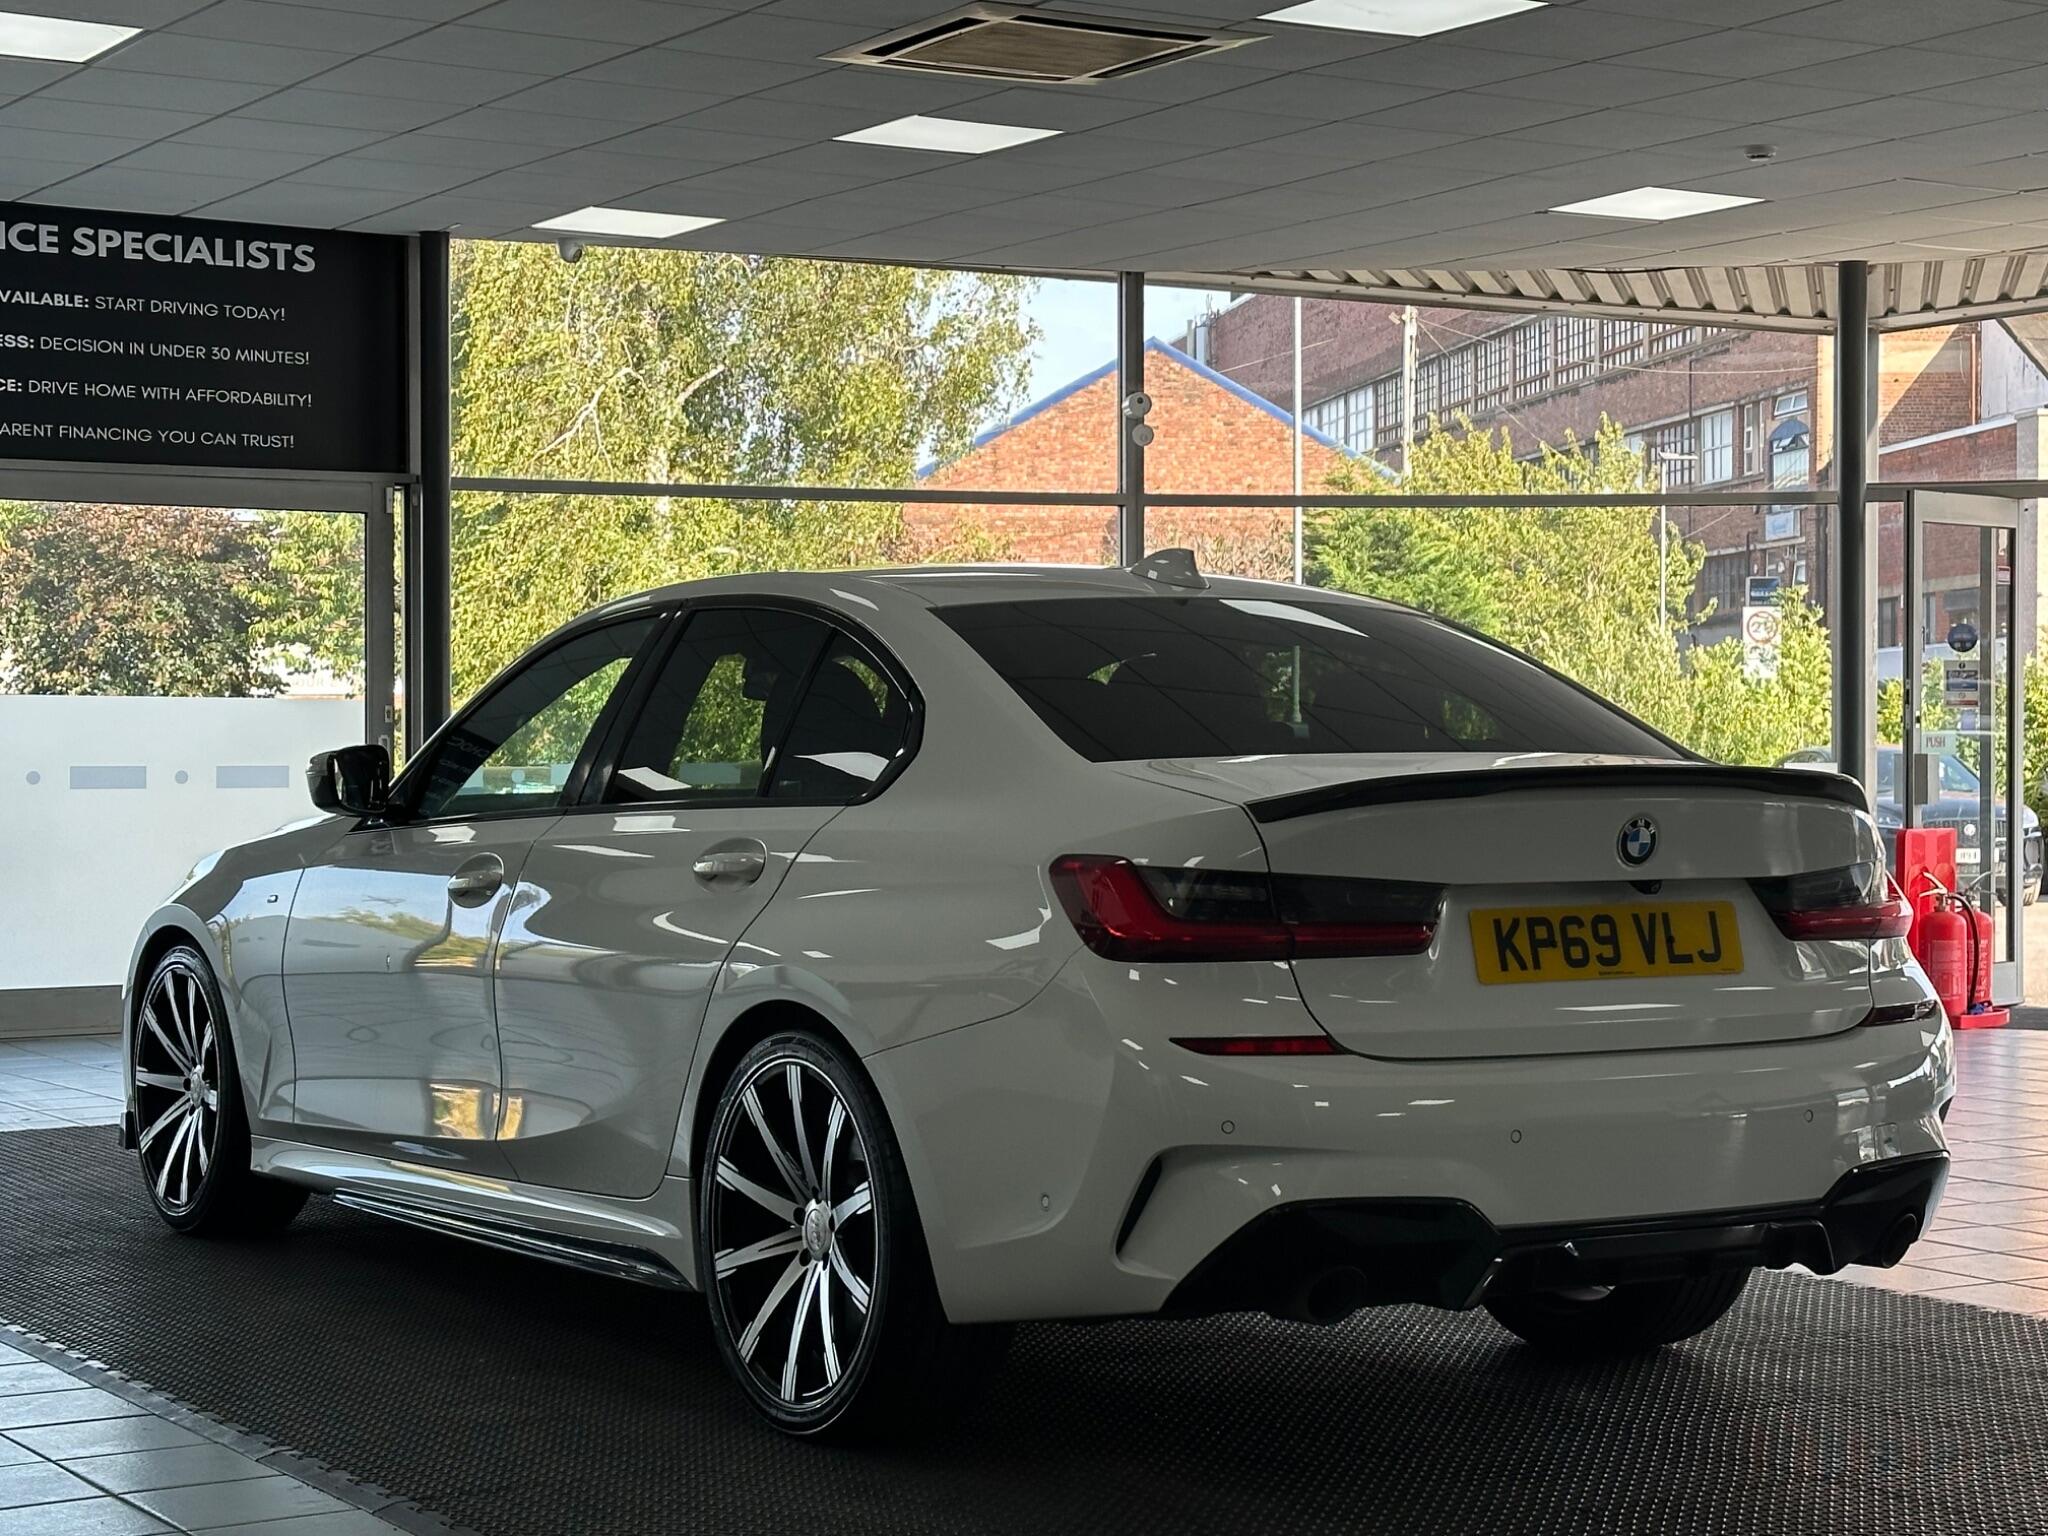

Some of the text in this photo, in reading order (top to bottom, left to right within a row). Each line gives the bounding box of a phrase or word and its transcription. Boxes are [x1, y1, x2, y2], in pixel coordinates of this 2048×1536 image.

[0, 221, 316, 272] CE SPECIALISTS
[0, 289, 286, 322] VAILABLE: START DRIVING TODAY!
[40, 336, 124, 355] DECISION
[129, 341, 145, 356] IN
[150, 342, 206, 360] UNDER
[211, 346, 231, 361] 30
[235, 348, 310, 365] MINUTES!
[28, 379, 79, 396] DRIVE
[84, 382, 136, 399] HOME
[141, 385, 180, 401] WITH
[185, 388, 312, 407] AFFORDABILITY!
[0, 422, 295, 449] ARENT FINANCING YOU CAN TRUST!
[1926, 736, 1946, 748] PUSH
[1492, 910, 1722, 972] KP69 VLJ
